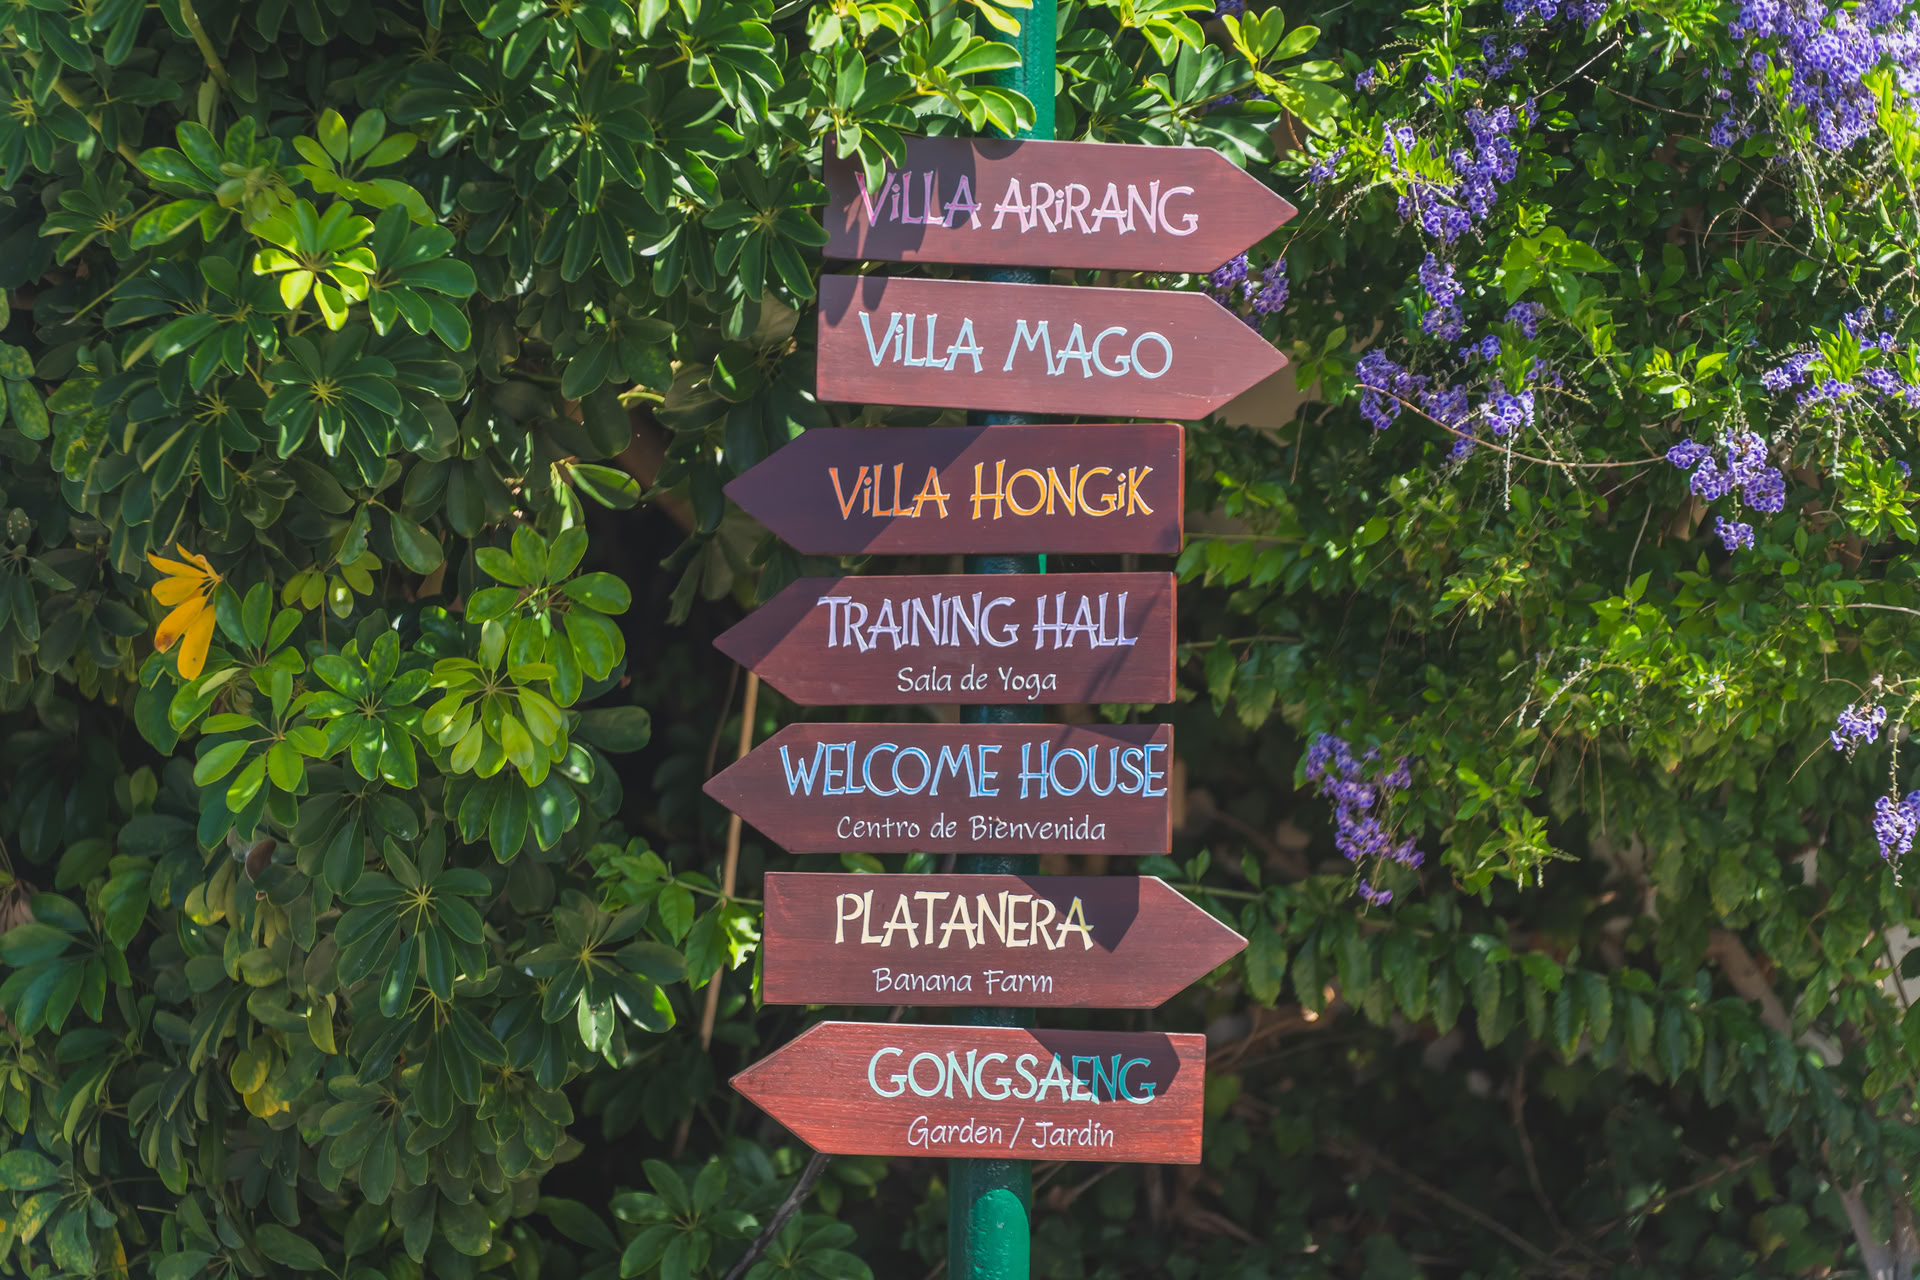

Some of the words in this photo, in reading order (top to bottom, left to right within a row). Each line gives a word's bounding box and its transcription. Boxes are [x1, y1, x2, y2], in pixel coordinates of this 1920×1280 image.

[1003, 319, 1173, 379] MAGO
[816, 591, 1019, 654] TRAINING
[1032, 591, 1138, 651] HALL
[897, 665, 952, 693] Sala
[960, 664, 988, 691] de
[998, 666, 1057, 700] Yoga
[778, 740, 1002, 798] WELCOME
[1017, 739, 1168, 799] HOUSE
[836, 815, 920, 839] Centro
[930, 813, 957, 838] de
[969, 814, 1106, 841] Bienvenida
[834, 889, 1094, 951] PLATANERA
[872, 967, 972, 995] Banana
[983, 969, 1053, 995] Farm
[867, 1047, 1156, 1105] GONGSAENG
[907, 1116, 1002, 1146] Garden
